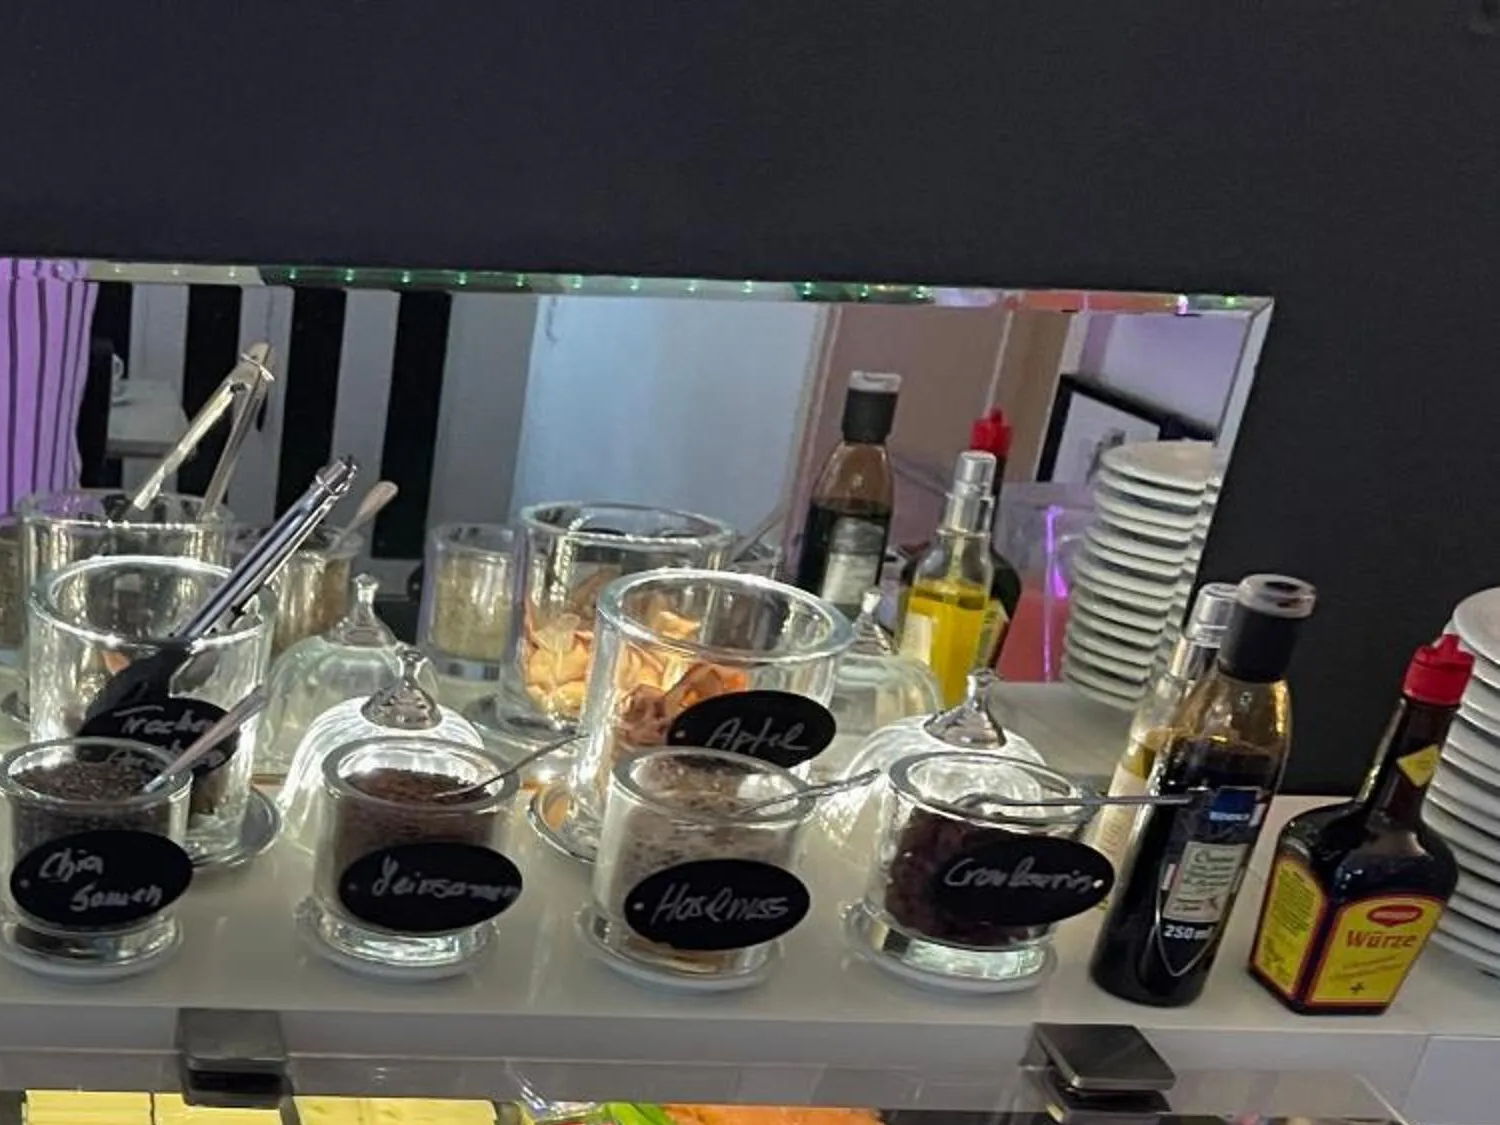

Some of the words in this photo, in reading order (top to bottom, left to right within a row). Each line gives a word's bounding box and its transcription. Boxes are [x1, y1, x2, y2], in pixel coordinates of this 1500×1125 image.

[704, 716, 808, 753] Apfel
[38, 847, 104, 882] Chia
[1162, 924, 1194, 940] 250
[1346, 928, 1418, 950] Würze
